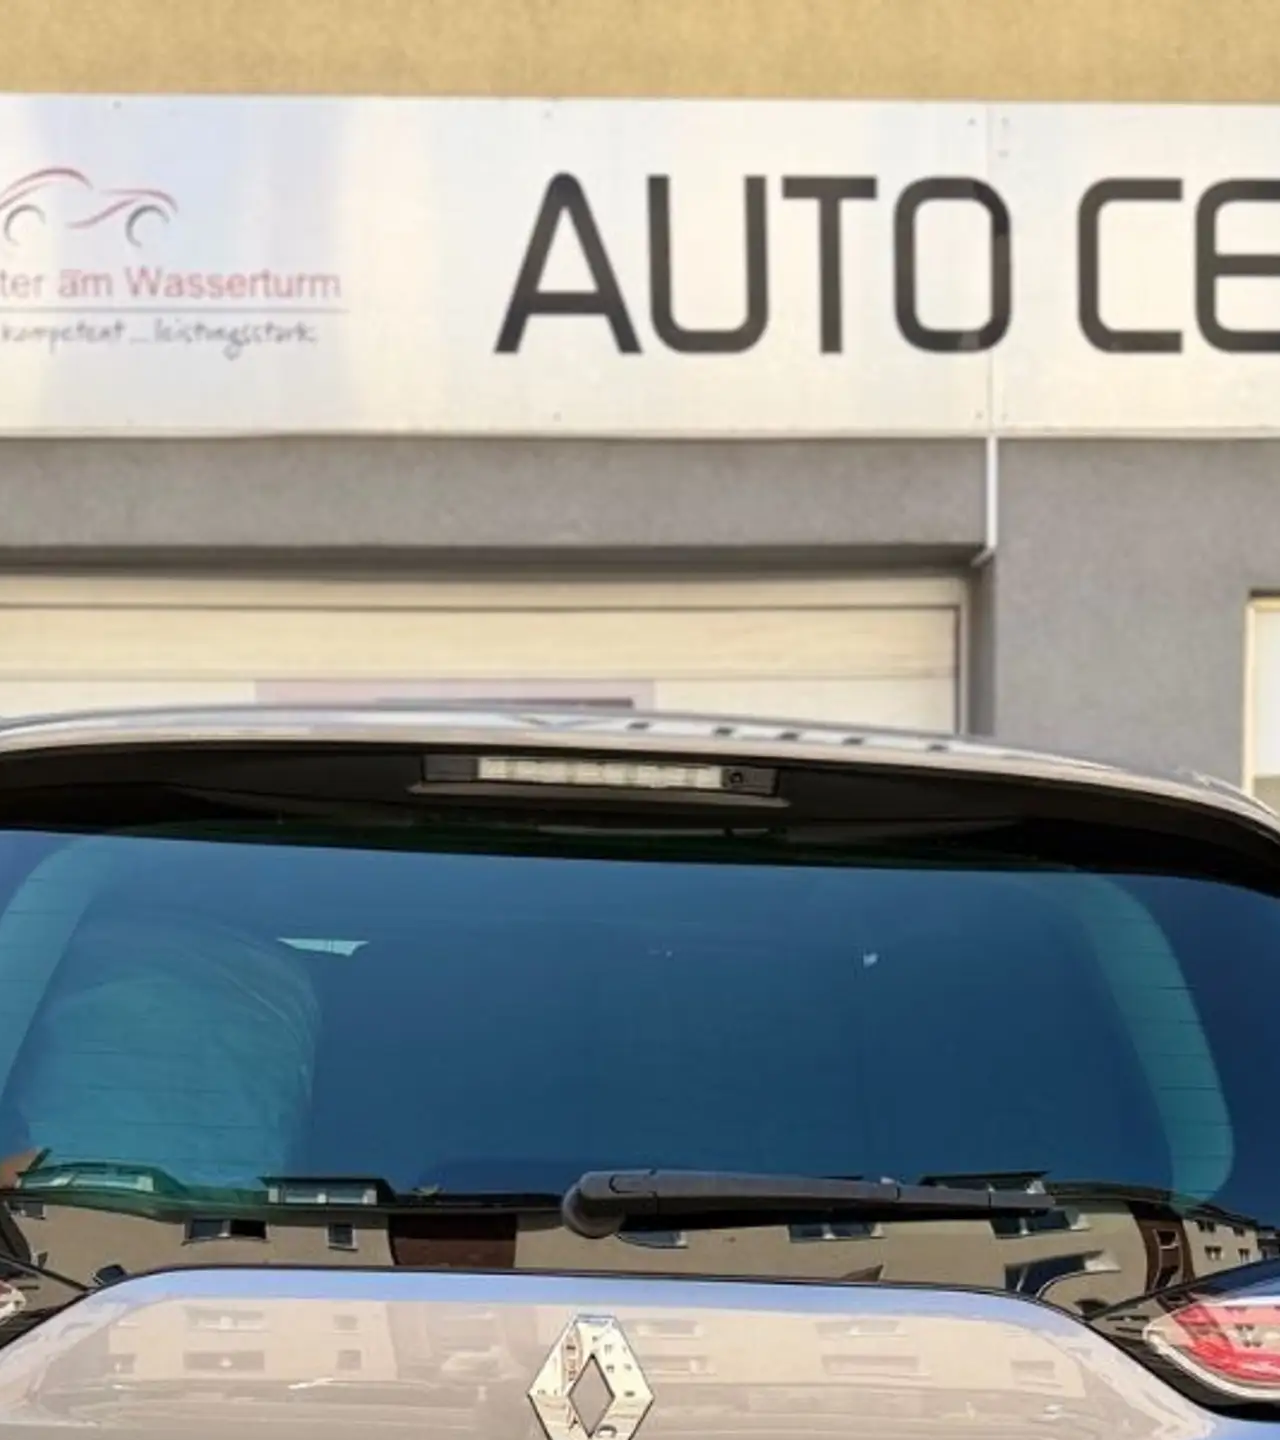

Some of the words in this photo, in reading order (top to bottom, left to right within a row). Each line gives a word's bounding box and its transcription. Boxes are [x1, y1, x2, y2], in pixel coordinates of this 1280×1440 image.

[58, 269, 114, 299] am
[125, 265, 342, 299] Wasserturm
[494, 171, 1012, 355] AUTO
